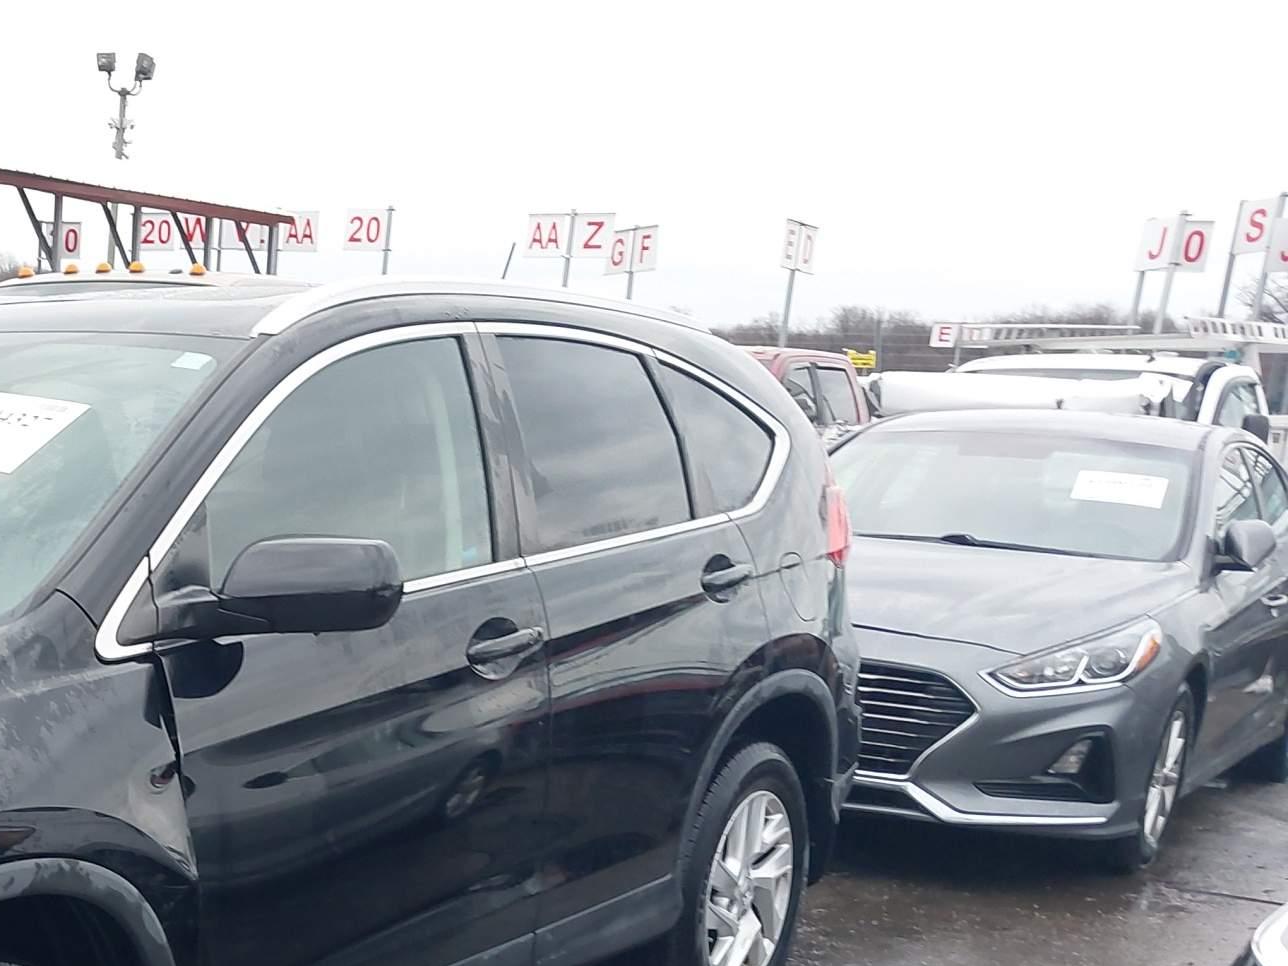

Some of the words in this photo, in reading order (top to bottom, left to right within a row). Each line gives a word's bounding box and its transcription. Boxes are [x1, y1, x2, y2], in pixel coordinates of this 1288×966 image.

[141, 219, 172, 245] 20
[347, 216, 381, 244] 20
[529, 221, 560, 249] AA
[583, 221, 605, 249] Z
[1245, 208, 1268, 243] S
[610, 237, 625, 266] G
[639, 233, 652, 264] F
[1147, 226, 1168, 261] J
[938, 326, 952, 343] E
